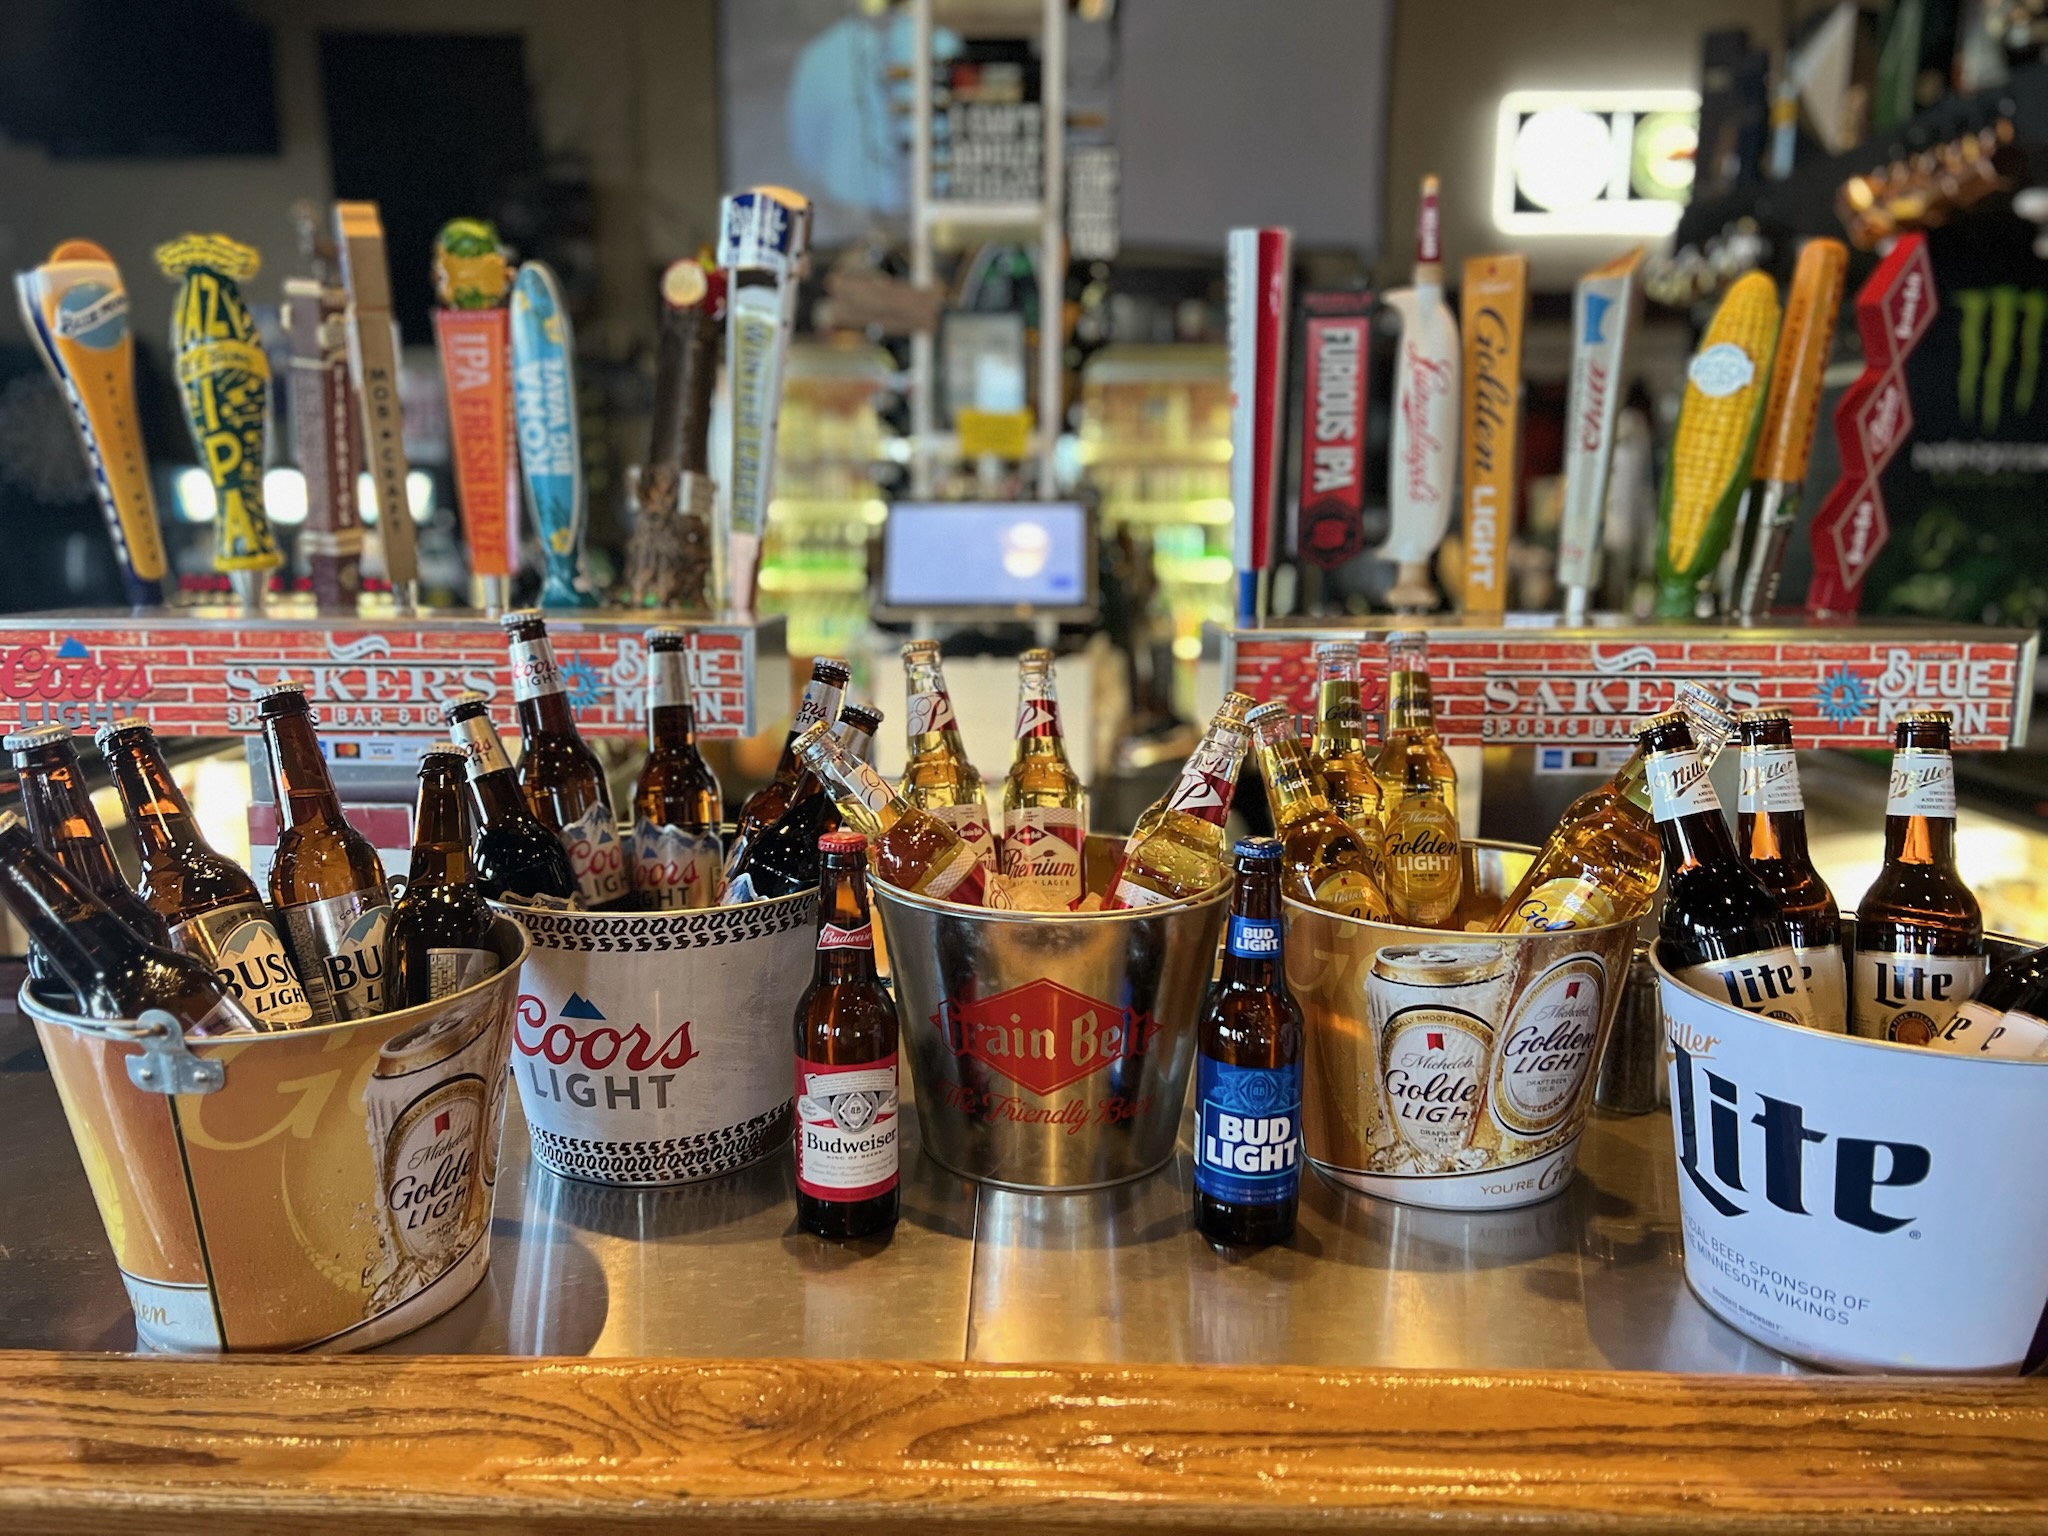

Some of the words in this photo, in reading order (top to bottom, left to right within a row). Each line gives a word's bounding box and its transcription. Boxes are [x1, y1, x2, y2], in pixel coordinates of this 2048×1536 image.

[452, 332, 492, 391] IPA
[543, 358, 572, 421] WAVE
[1316, 326, 1361, 441] FURIOUS
[1470, 306, 1513, 474] Golden
[517, 362, 555, 476] KONA
[552, 423, 574, 475] BIG
[1312, 445, 1355, 493] IPA
[1465, 485, 1501, 592] LIGHT
[0, 644, 153, 700] Coors
[1877, 648, 1991, 698] BLUE
[612, 688, 725, 723] MN
[1403, 707, 1430, 718] LIGHT
[1483, 678, 1763, 714] SAKE'S
[227, 706, 322, 726] SPS
[337, 707, 382, 726] BAR
[1482, 720, 1579, 738] SPORTS
[1283, 778, 1313, 793] LIGHT
[1385, 829, 1458, 857] Golden
[1004, 848, 1078, 880] Premium
[1041, 879, 1071, 887] LAGER
[1396, 855, 1452, 872] LIGHT
[1235, 936, 1280, 952] LIGHT
[1243, 926, 1274, 940] BUD
[1717, 961, 1798, 1014] Lite
[1873, 960, 1954, 1010] Lite
[511, 993, 701, 1072] Coors
[937, 999, 1057, 1061] Grain
[1070, 1008, 1152, 1068] Belt
[1504, 1019, 1593, 1058] Golden
[1662, 1012, 1722, 1054] Miller
[1400, 1052, 1475, 1071] Michelob
[1512, 1051, 1586, 1075] LIGHT
[528, 1061, 677, 1111] LIGHT
[1385, 1069, 1478, 1103] Golde
[1526, 1078, 1550, 1088] DRAFT
[981, 1092, 1091, 1136] Friendly
[1218, 1112, 1291, 1146] BUD
[1669, 1034, 1932, 1233] Lite
[806, 1127, 897, 1154] Budweiser
[1206, 1136, 1298, 1173] LIGHT
[1480, 1176, 1535, 1196] YOU'RE
[1696, 1239, 1771, 1300] MINNESOTA
[1774, 1287, 1851, 1326] VIKINGS
[1711, 1236, 1746, 1269] BEER
[1749, 1259, 1838, 1305] SPONSOR
[1842, 1294, 1872, 1313] OF
